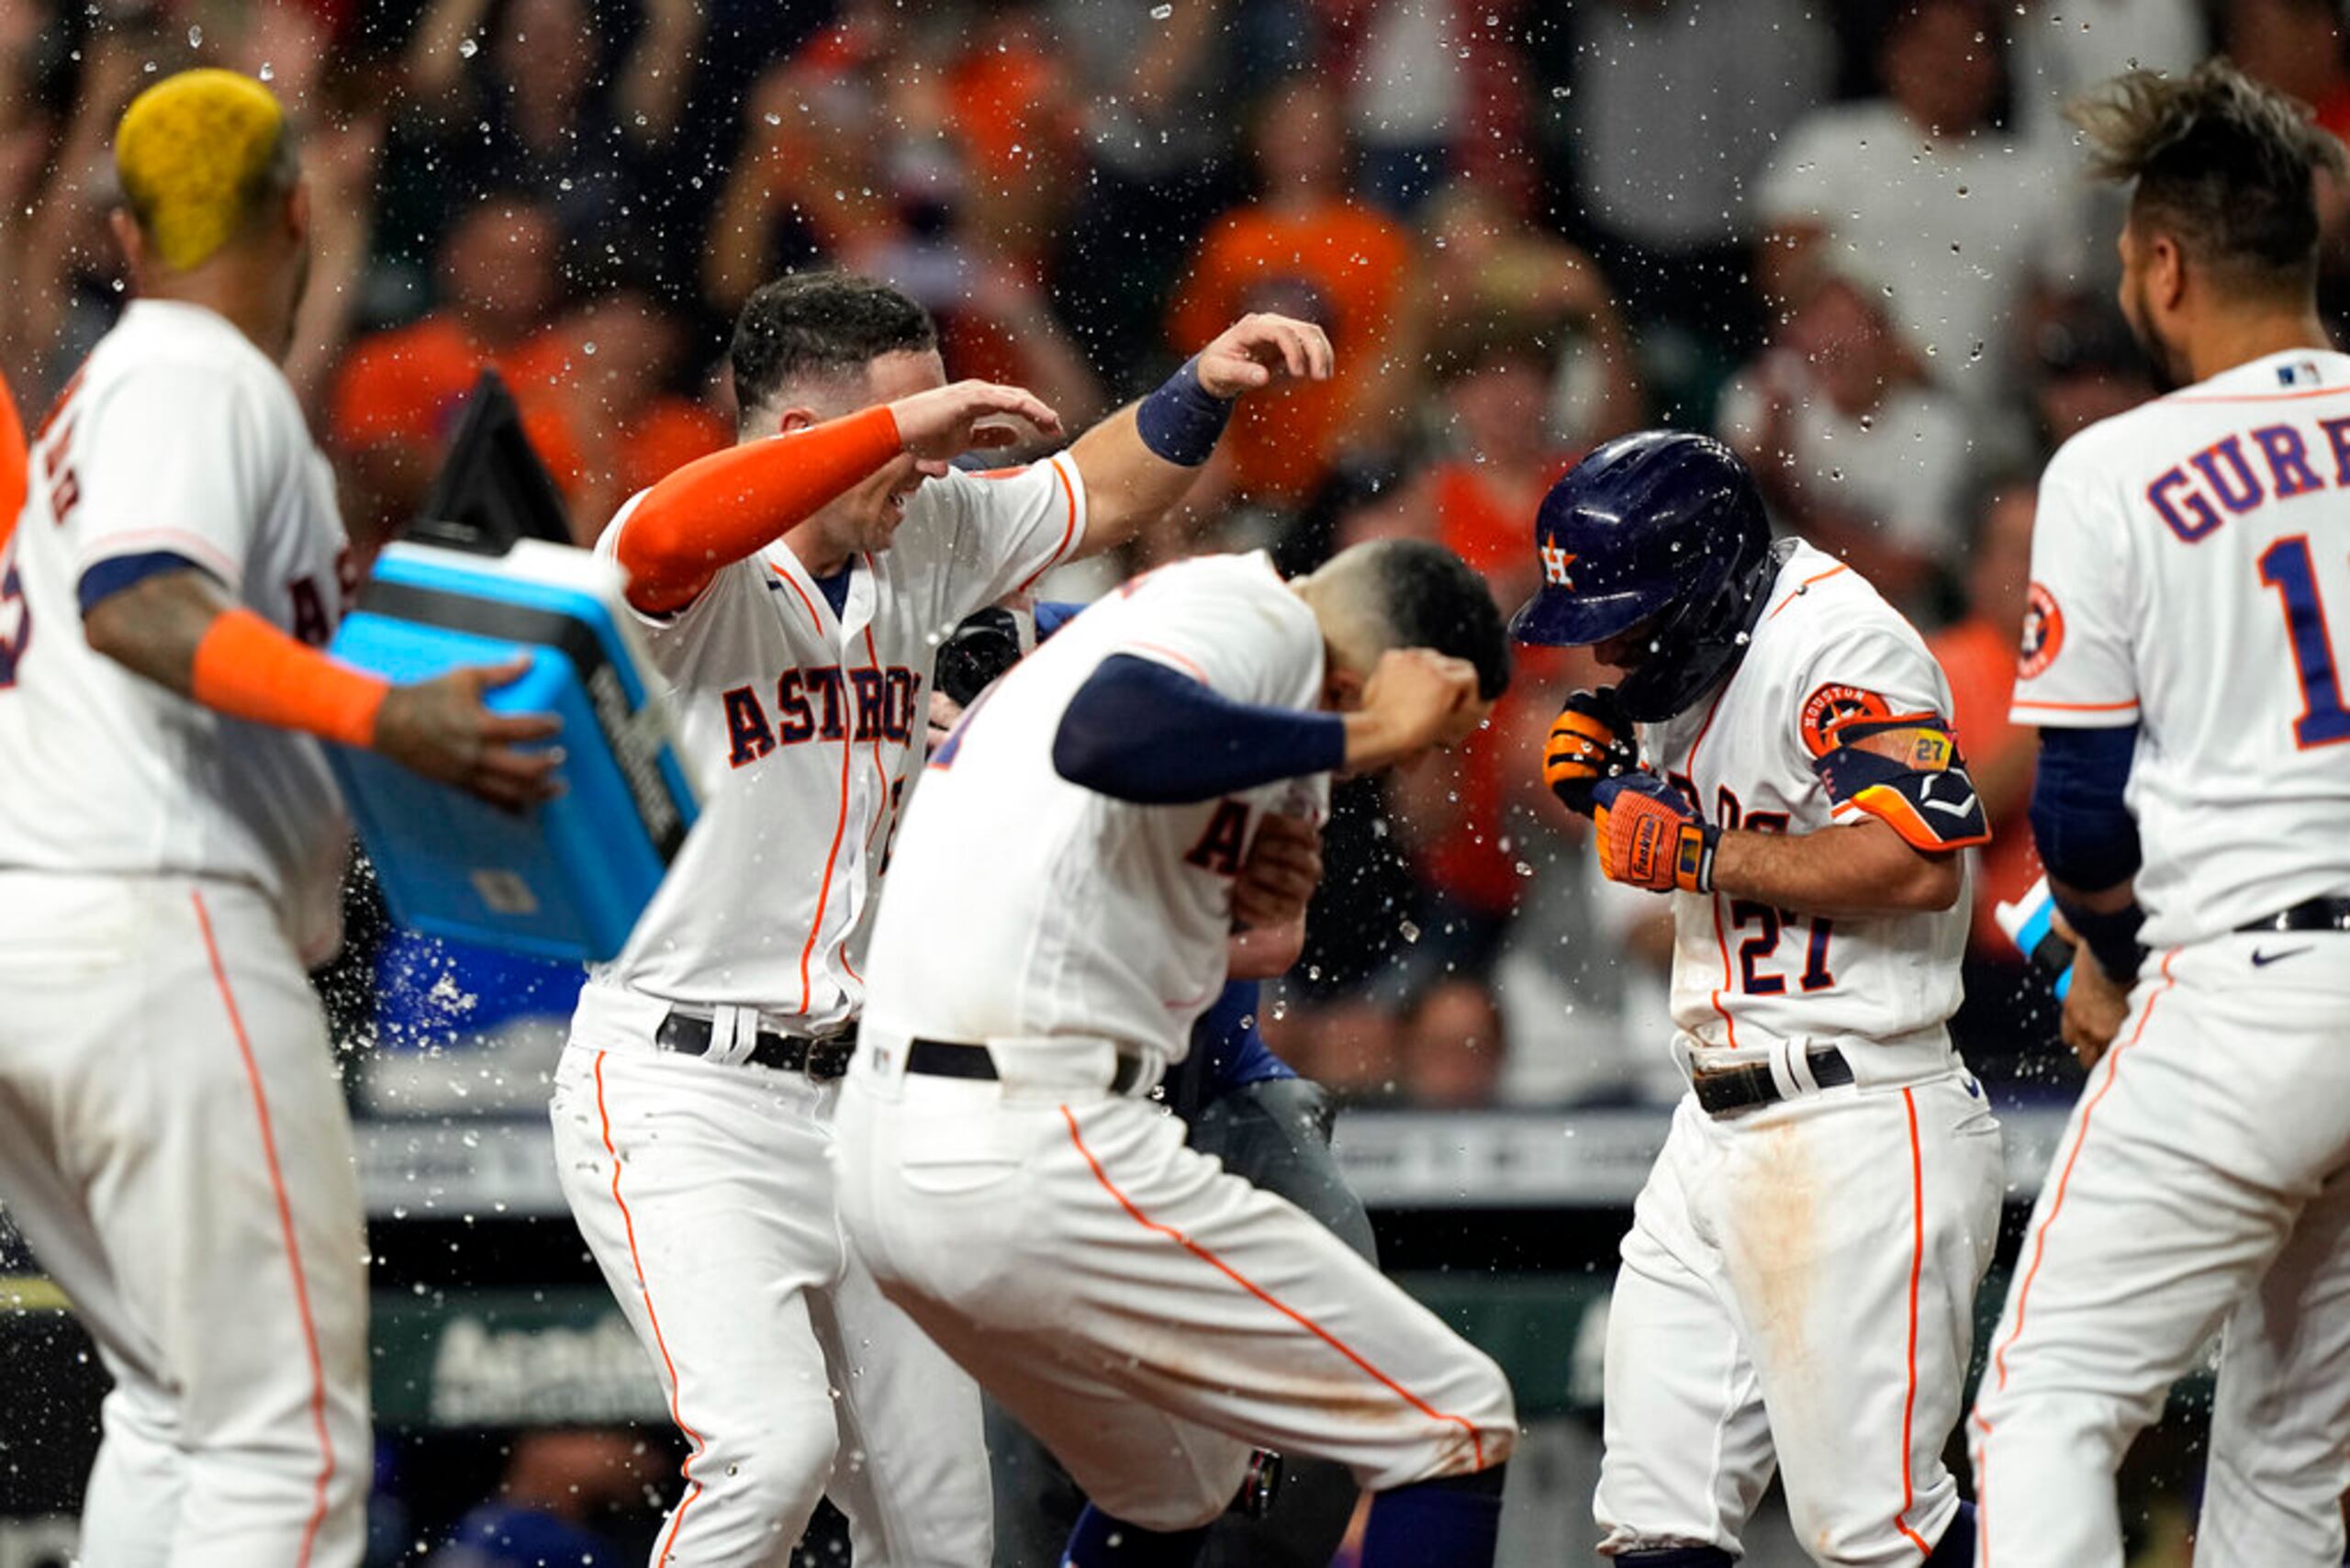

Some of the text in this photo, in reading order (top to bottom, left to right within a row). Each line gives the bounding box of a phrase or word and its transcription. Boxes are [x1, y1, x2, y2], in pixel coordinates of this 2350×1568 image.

[722, 665, 921, 770] ASTRO
[1804, 686, 1865, 728] HOUSTON
[1916, 738, 1944, 761] 27
[1729, 898, 1836, 995] 27
